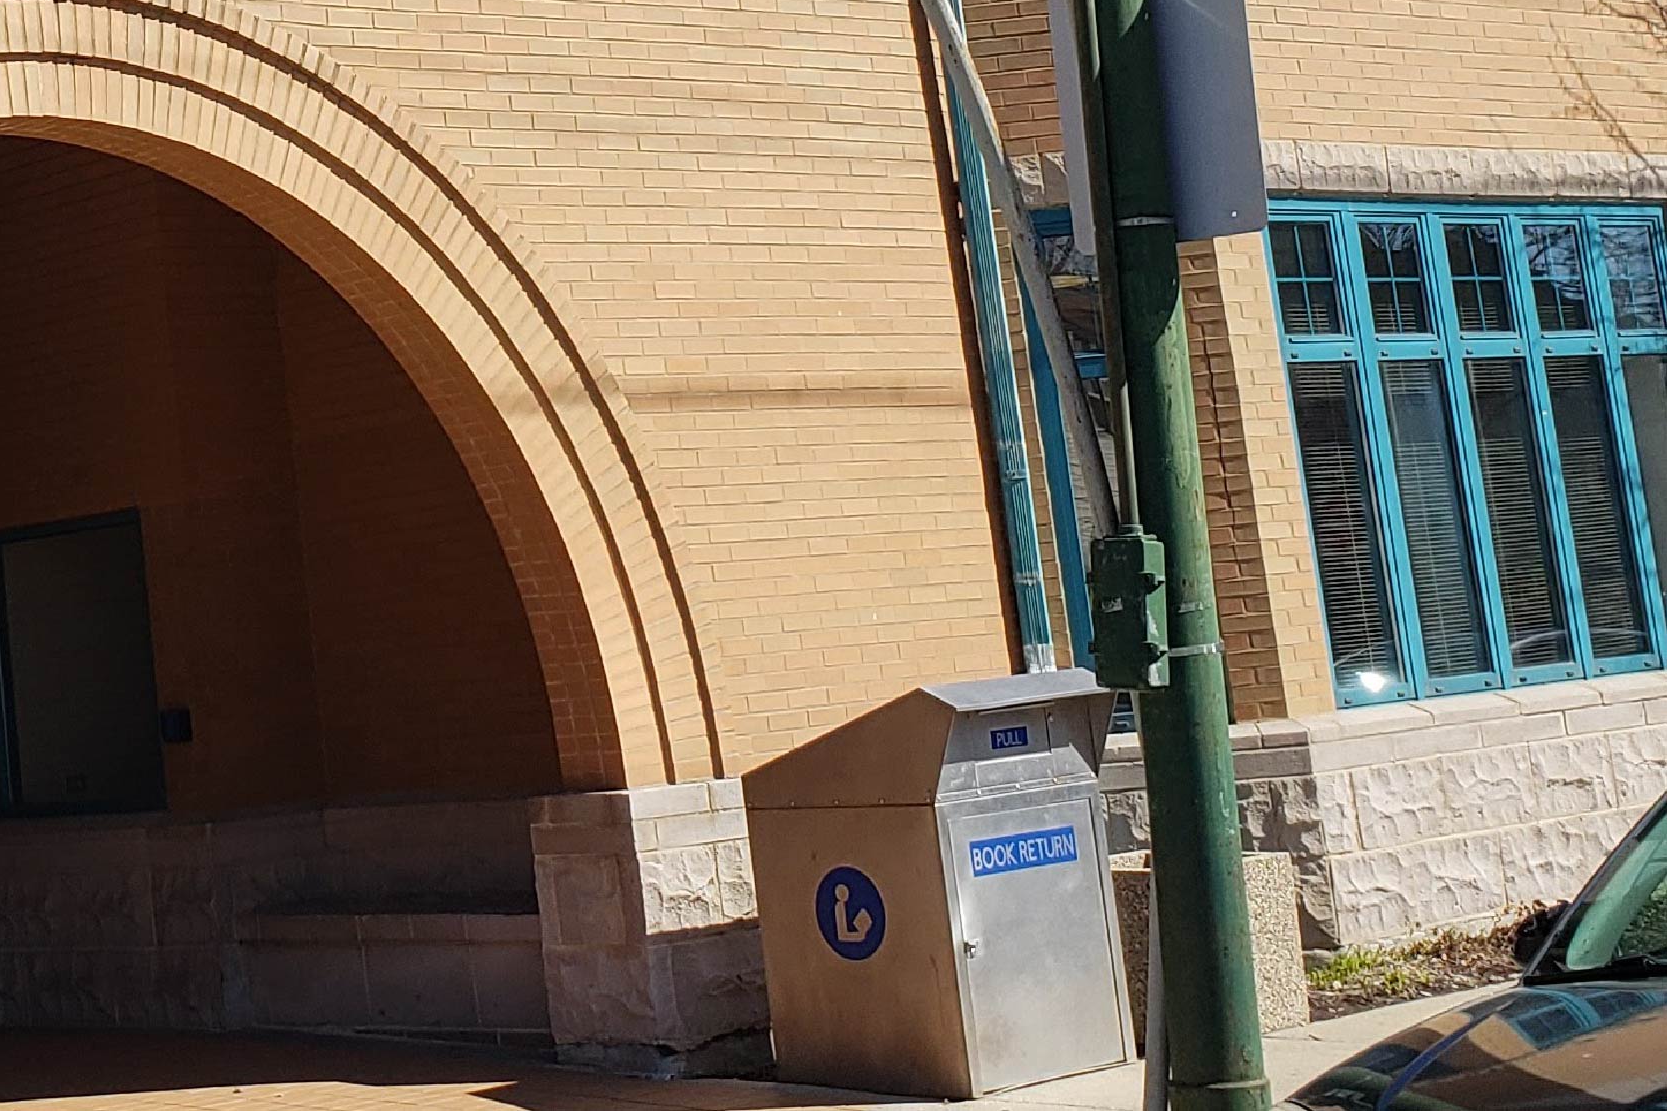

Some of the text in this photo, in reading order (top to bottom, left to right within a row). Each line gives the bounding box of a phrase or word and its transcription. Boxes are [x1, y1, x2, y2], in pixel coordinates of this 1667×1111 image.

[996, 731, 1023, 747] PULL
[973, 833, 1075, 870] BOOK RETURN
